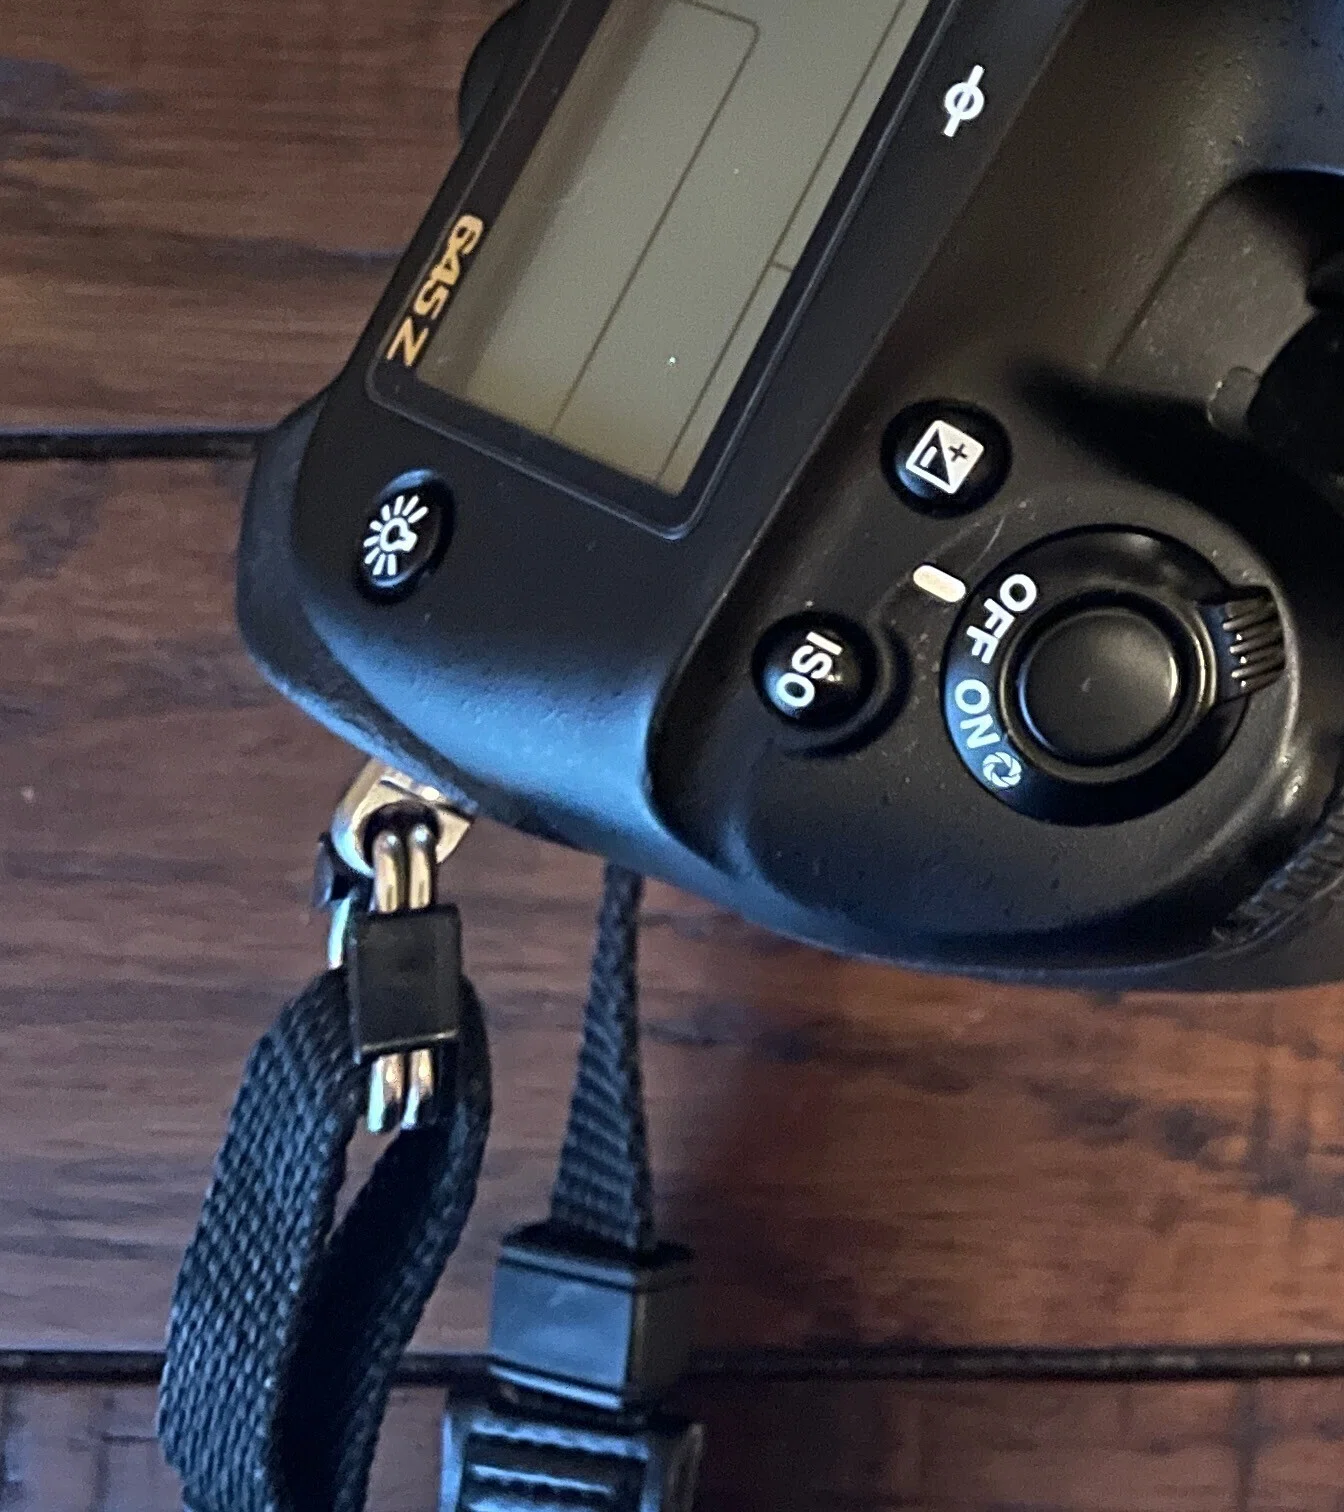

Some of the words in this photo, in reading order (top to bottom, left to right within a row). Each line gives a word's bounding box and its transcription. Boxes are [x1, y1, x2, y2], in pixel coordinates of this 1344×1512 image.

[966, 573, 1037, 664] OFF
[775, 631, 843, 709] ISO
[954, 678, 1002, 749] ON
